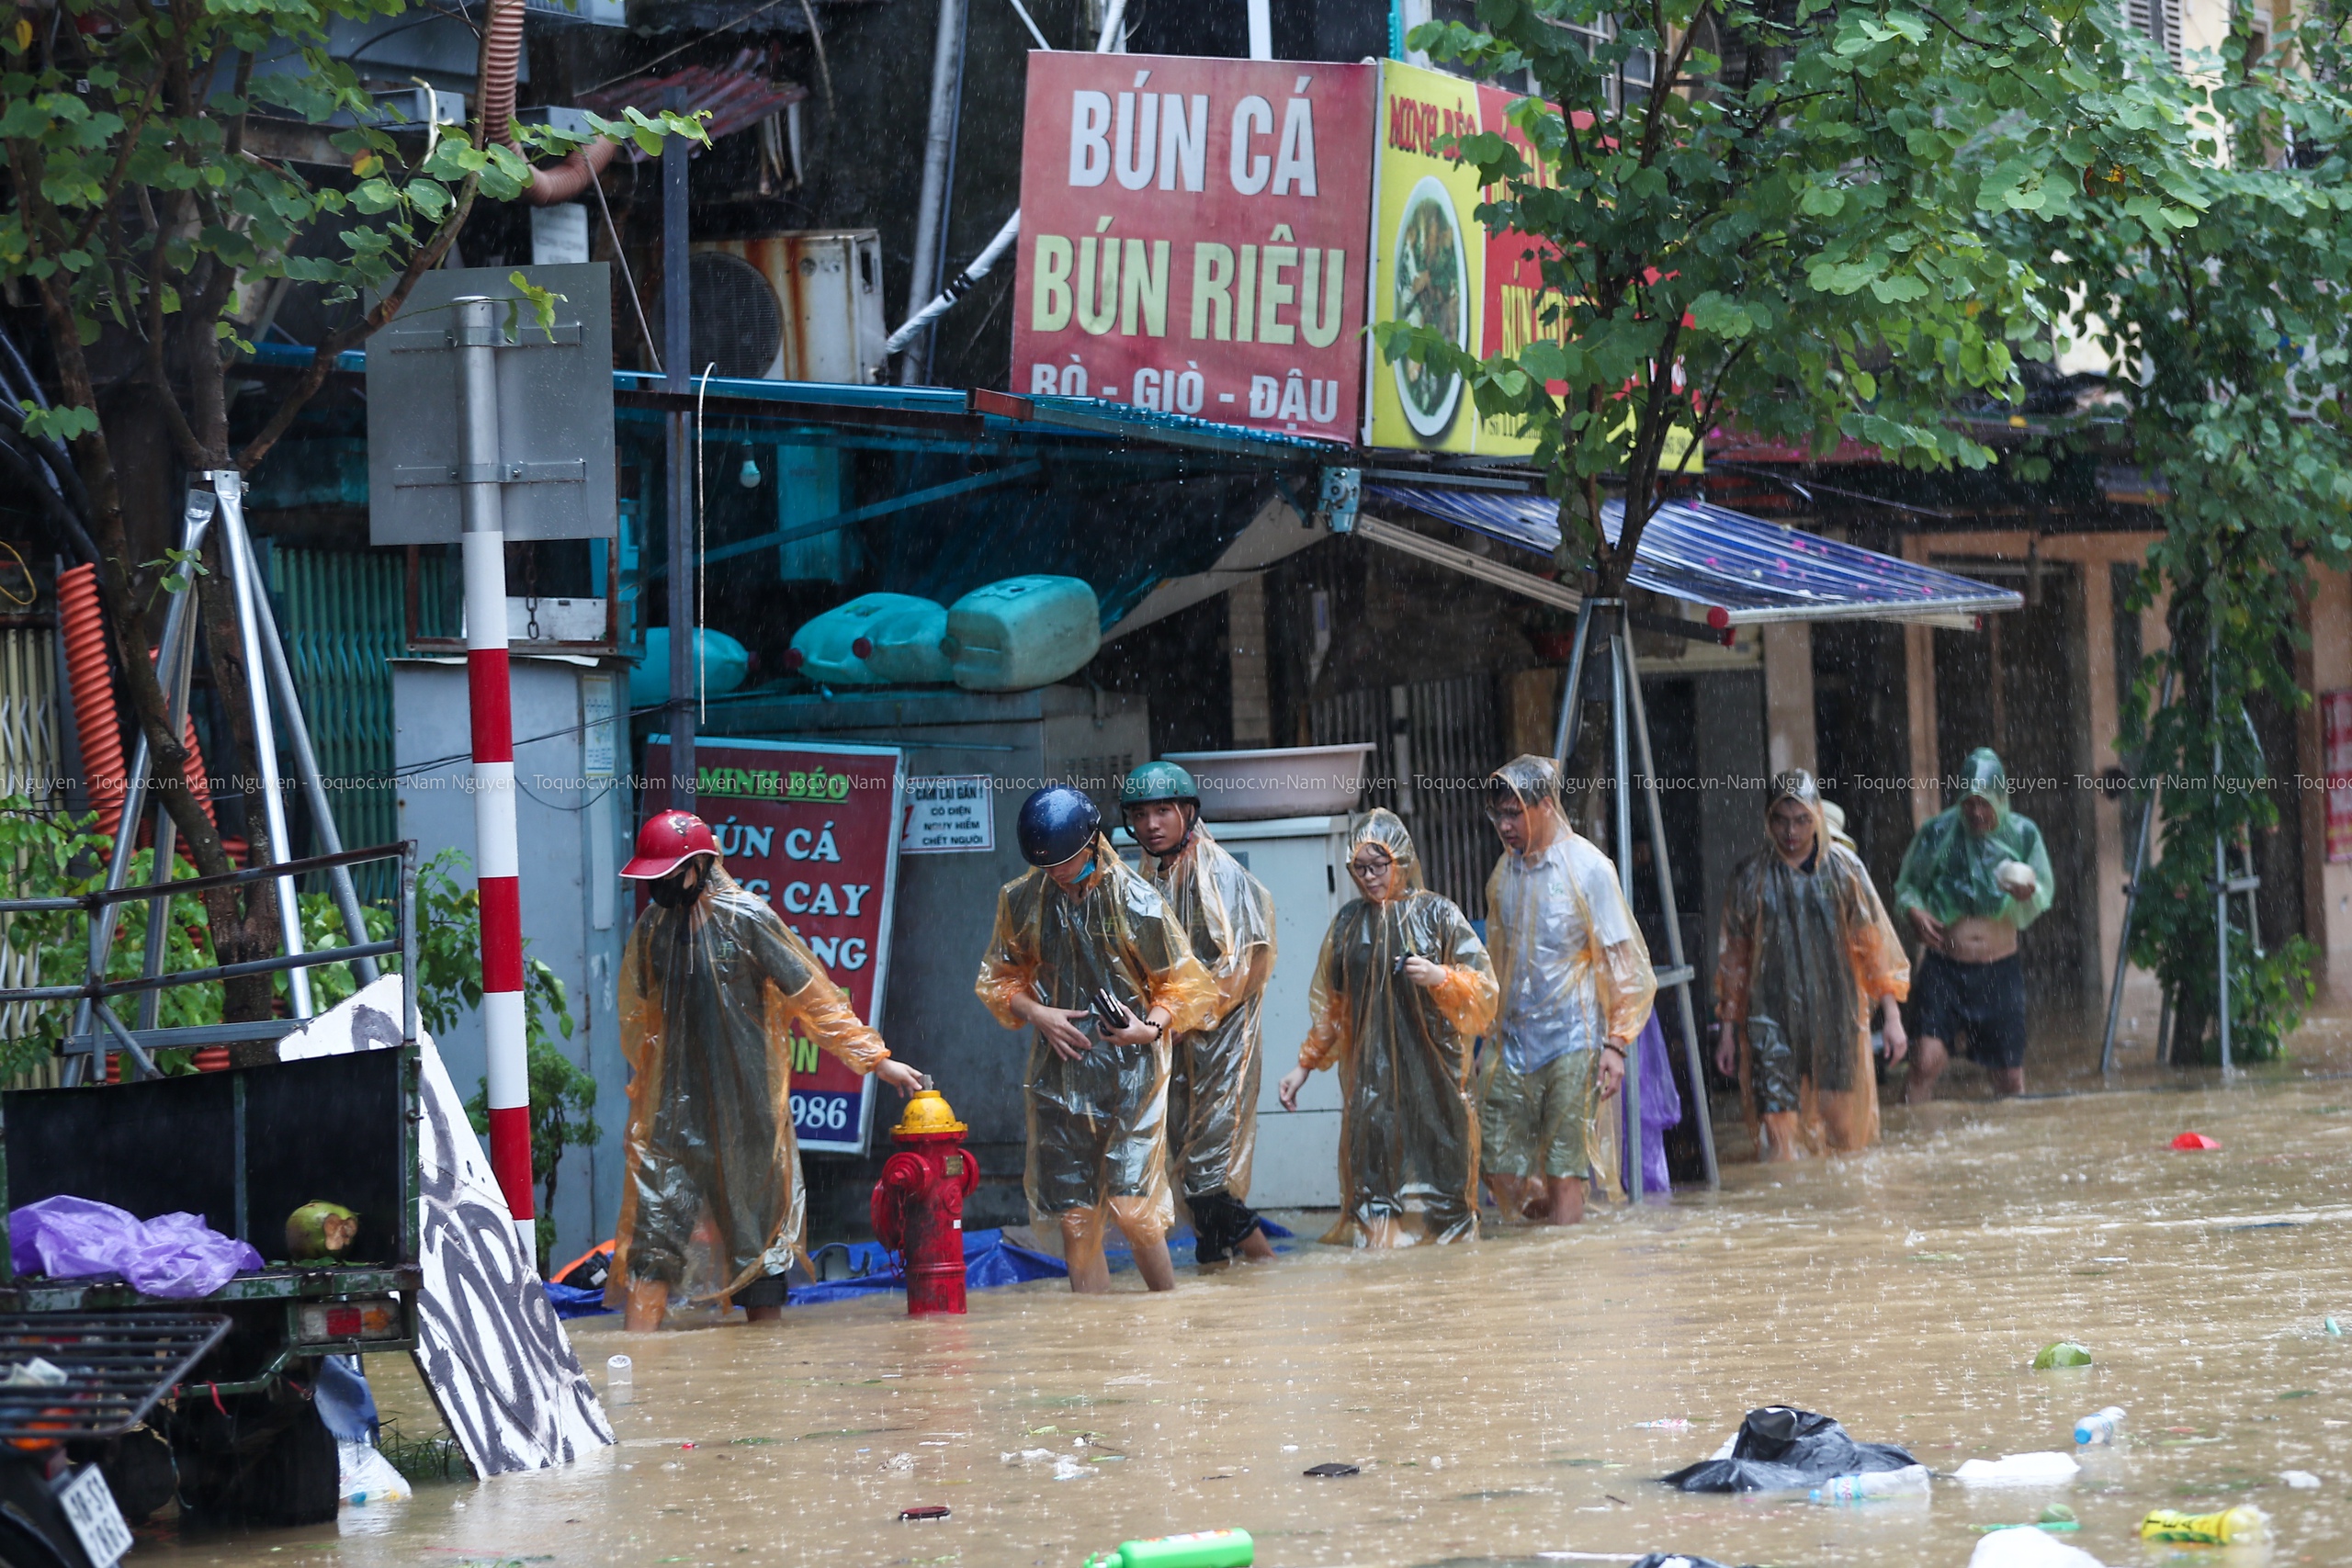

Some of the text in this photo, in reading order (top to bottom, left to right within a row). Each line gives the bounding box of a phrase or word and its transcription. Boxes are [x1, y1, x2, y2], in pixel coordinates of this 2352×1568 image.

[1069, 70, 1317, 197] BÚN CÁ
[1389, 94, 1438, 158] MINH
[1031, 216, 1345, 348] BÚN RIÊU
[1031, 354, 1088, 397] BÒ
[1133, 361, 1204, 413] GIÒ
[1249, 368, 1338, 430] ĐẬU
[698, 765, 849, 799] MINH BÉO
[707, 815, 842, 863] ÚN CÁ
[783, 880, 871, 917] CAY
